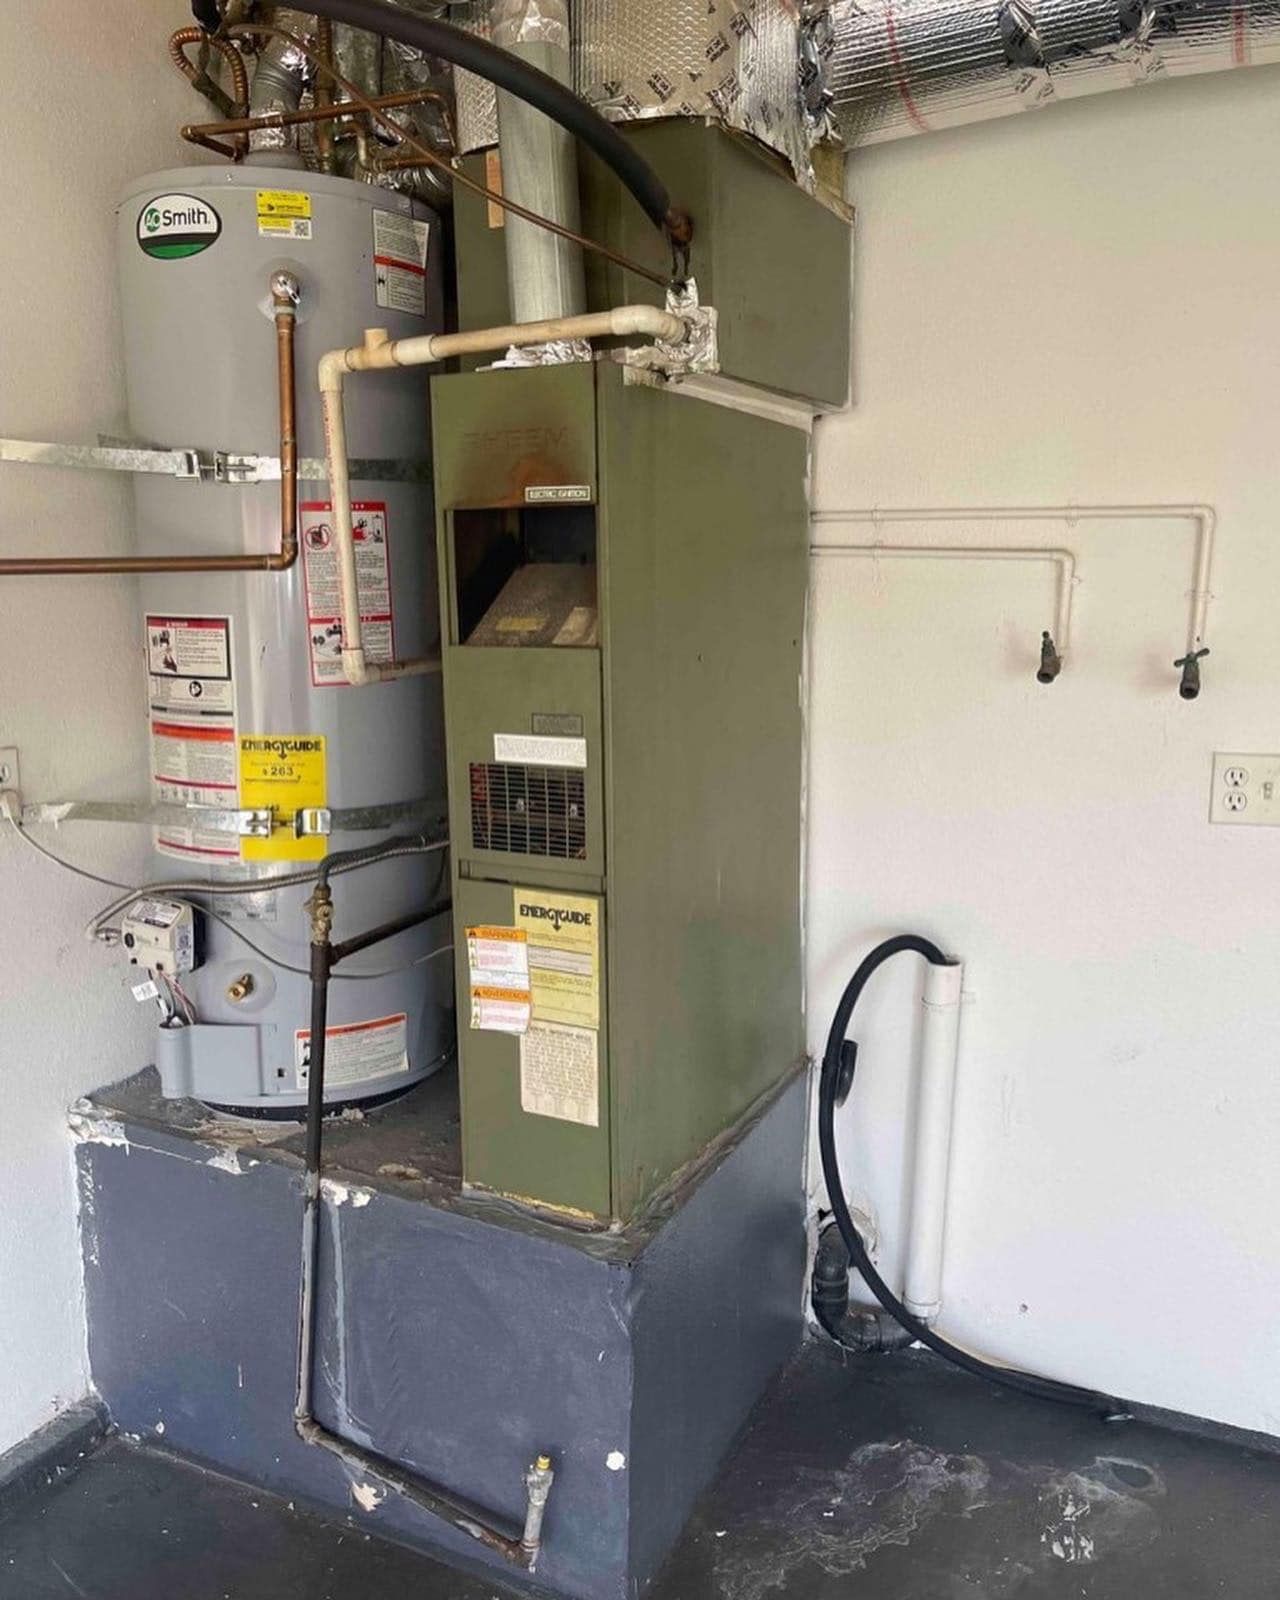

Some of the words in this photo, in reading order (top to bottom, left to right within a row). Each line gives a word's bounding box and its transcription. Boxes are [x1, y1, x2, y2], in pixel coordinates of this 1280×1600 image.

[162, 208, 208, 227] Smith
[241, 740, 322, 754] ENERGYGUIDE
[519, 904, 592, 927] ENERGYGUIDE
